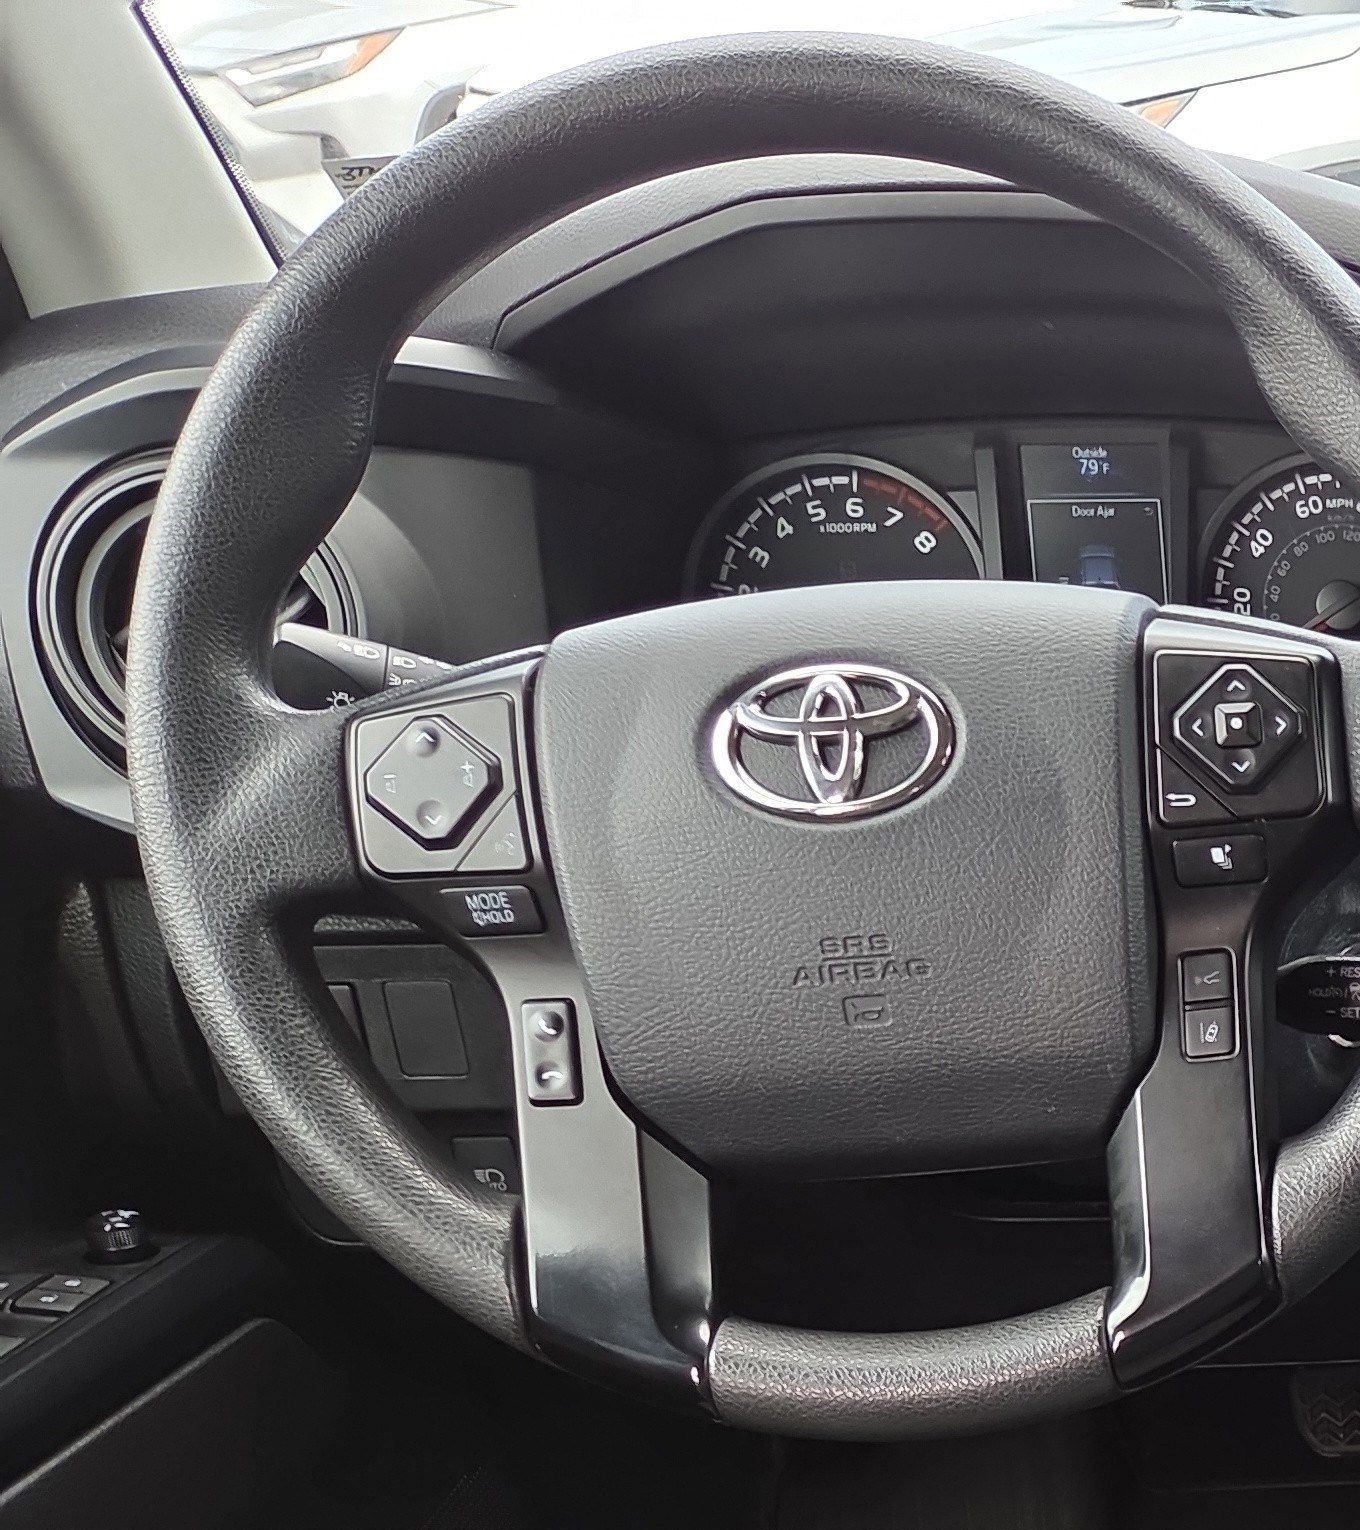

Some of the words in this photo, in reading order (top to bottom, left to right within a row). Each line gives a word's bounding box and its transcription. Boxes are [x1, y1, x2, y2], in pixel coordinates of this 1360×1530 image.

[1072, 446, 1107, 459] Outside
[806, 500, 827, 523] 5
[846, 497, 865, 518] 6
[1071, 505, 1095, 518] Door
[1295, 495, 1324, 518] 60
[1326, 498, 1353, 509] MPH
[882, 506, 904, 527] 7
[776, 516, 794, 539] 4
[1315, 530, 1336, 544] 100
[913, 530, 937, 554] 8
[1250, 528, 1273, 558] 40
[1292, 541, 1309, 557] 80
[749, 546, 770, 569] 3
[1275, 560, 1291, 577] 60
[465, 891, 512, 910] MODE
